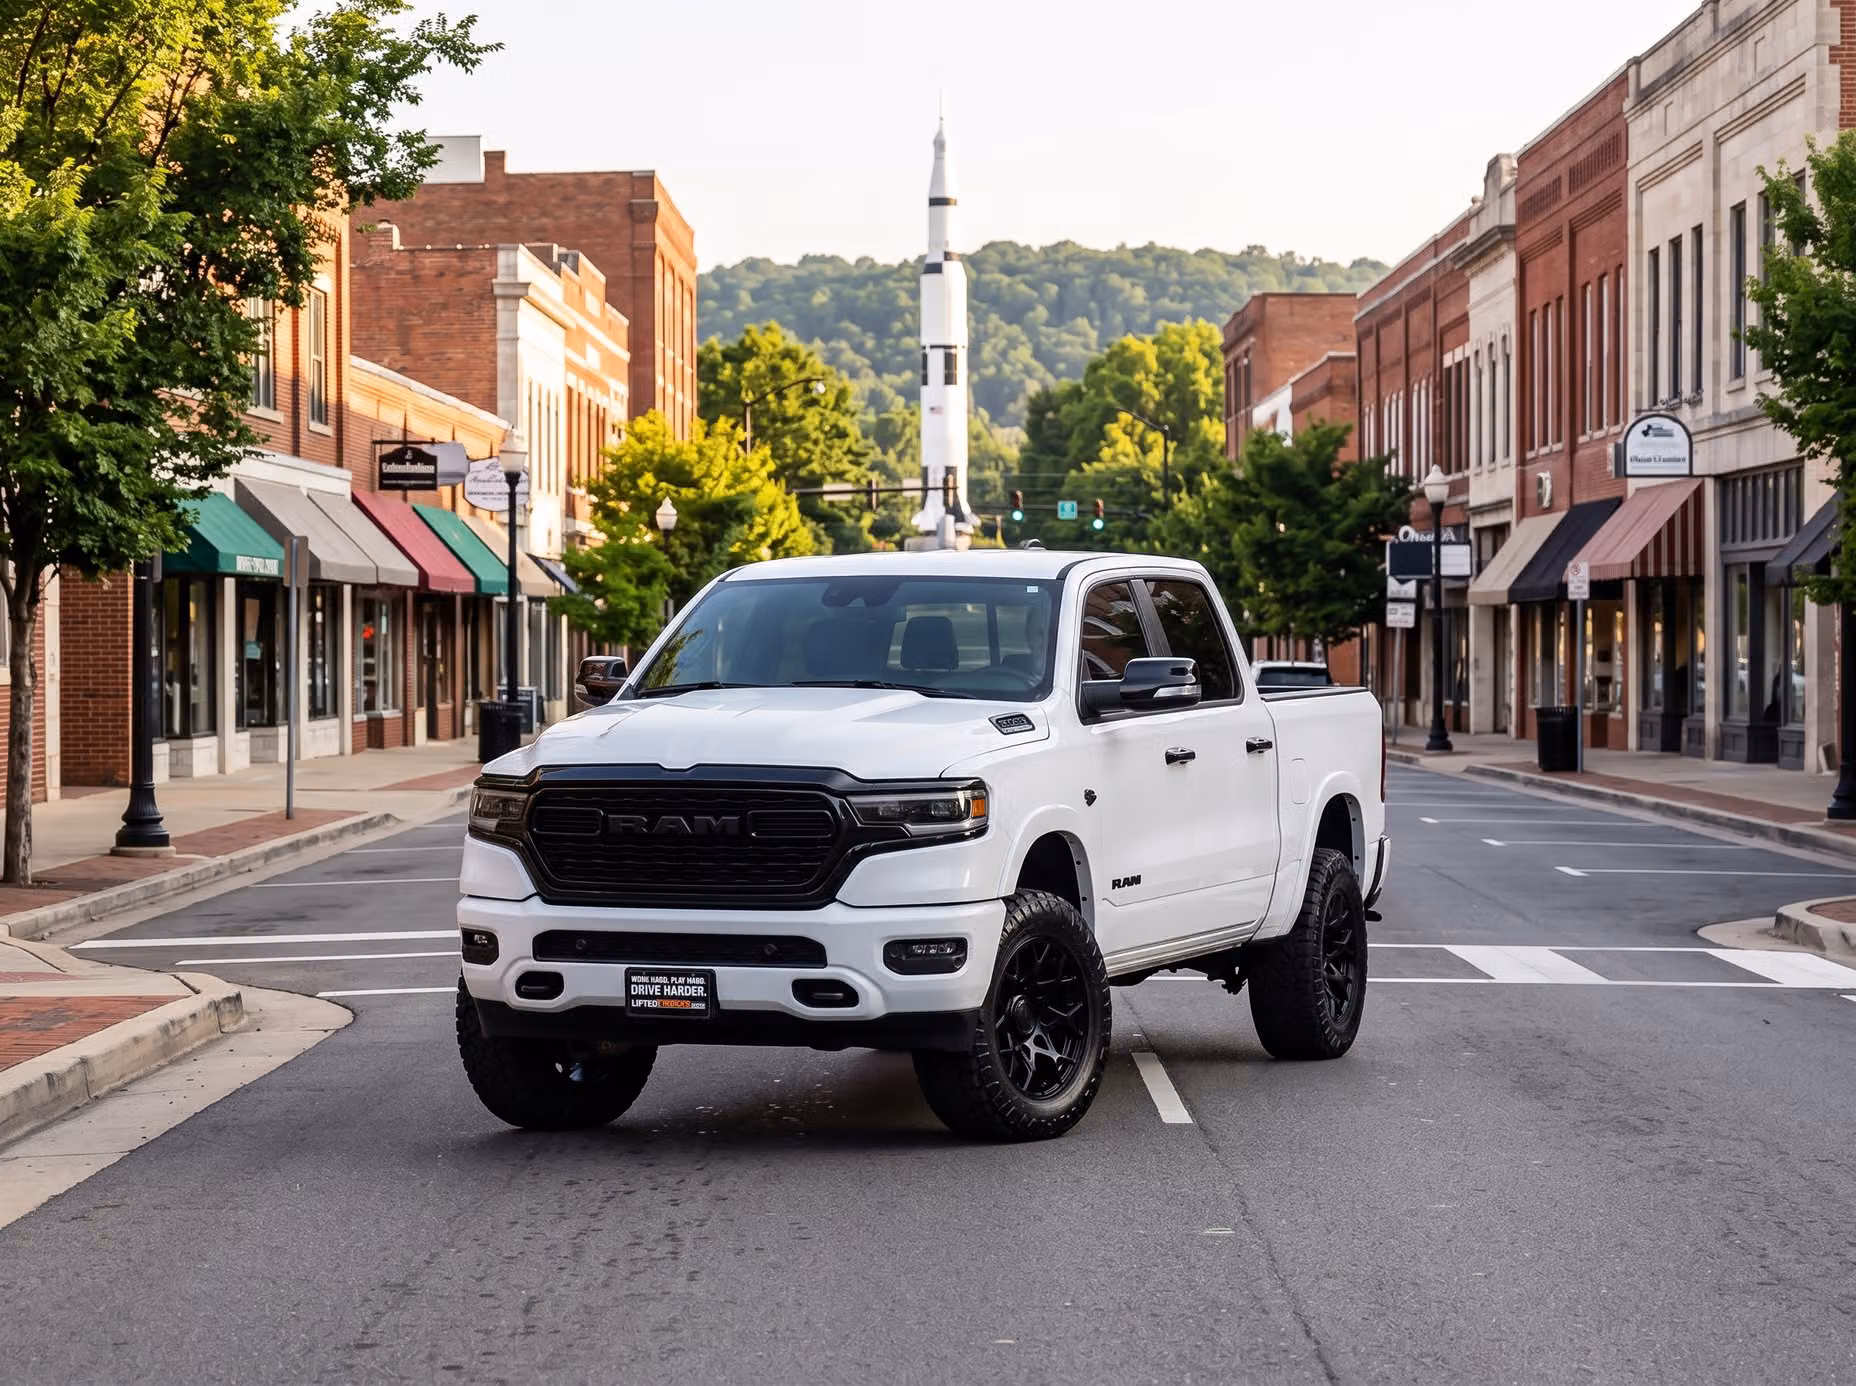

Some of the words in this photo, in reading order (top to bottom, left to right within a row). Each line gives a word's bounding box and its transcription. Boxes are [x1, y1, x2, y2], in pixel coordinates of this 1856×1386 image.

[607, 815, 741, 834] RAM
[1111, 874, 1141, 890] RAM
[631, 984, 661, 996] DRIVE
[663, 985, 707, 997] HARDER.
